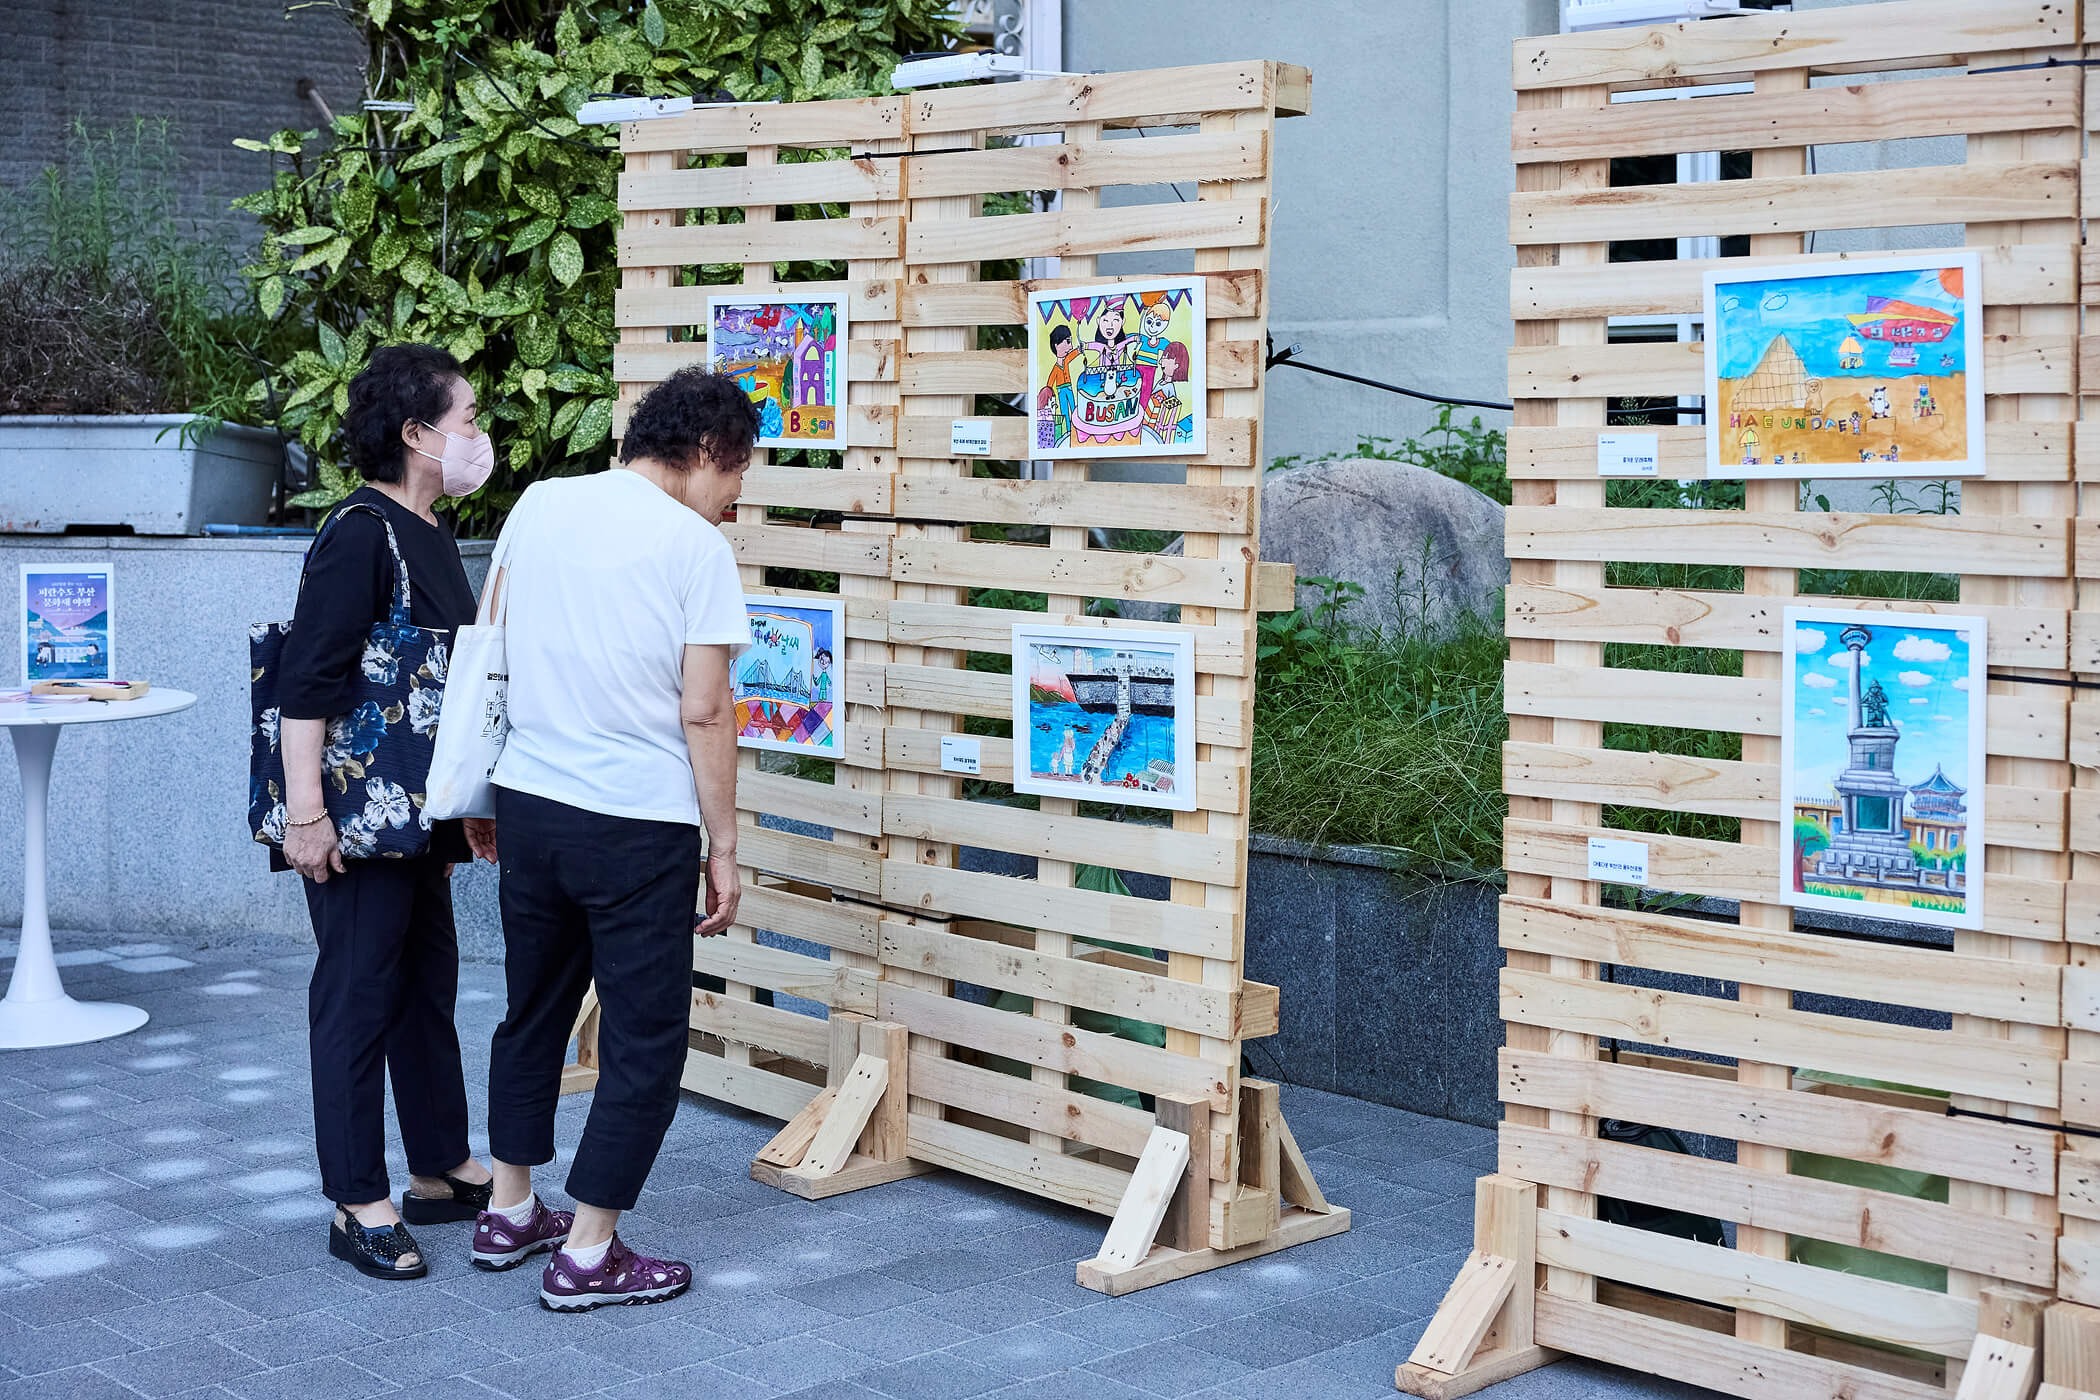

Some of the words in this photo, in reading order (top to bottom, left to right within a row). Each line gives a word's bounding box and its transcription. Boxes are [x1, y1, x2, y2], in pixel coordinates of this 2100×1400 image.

[1085, 397, 1138, 422] BUSAN
[790, 410, 834, 434] Busan
[1730, 413, 1847, 432] HAEUNDAE
